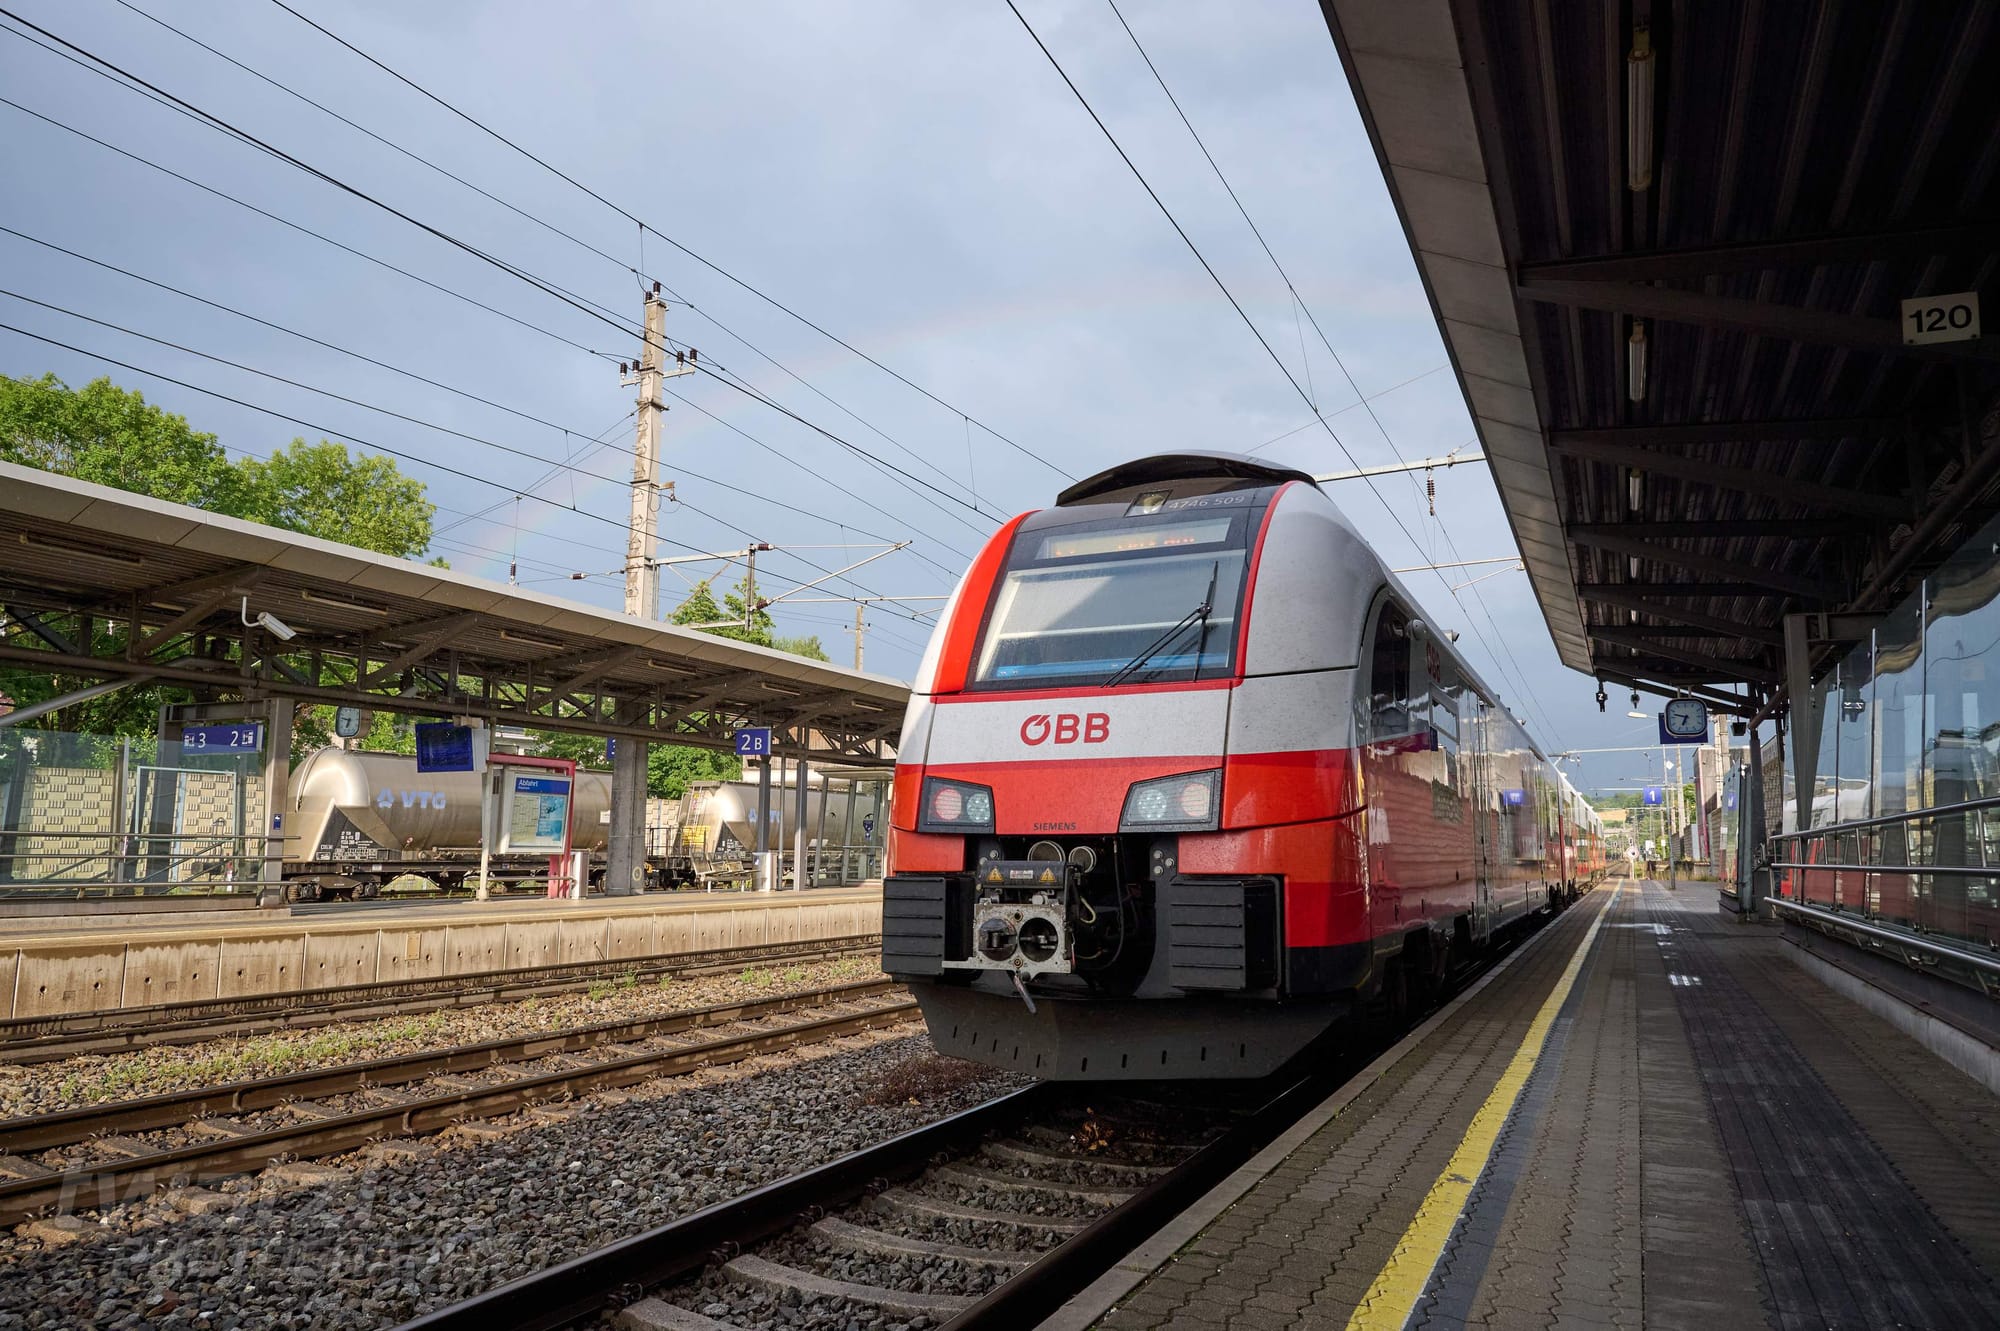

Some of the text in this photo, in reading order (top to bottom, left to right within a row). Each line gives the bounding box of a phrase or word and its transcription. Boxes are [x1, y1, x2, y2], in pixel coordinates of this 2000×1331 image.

[1908, 304, 1972, 333] 120
[1169, 496, 1245, 509] 4746 509
[1020, 712, 1110, 747] ÖBB
[198, 730, 239, 748] 3 2
[401, 790, 447, 809] VTG
[1649, 790, 1655, 802] 1
[1033, 822, 1077, 831] SIEMENS
